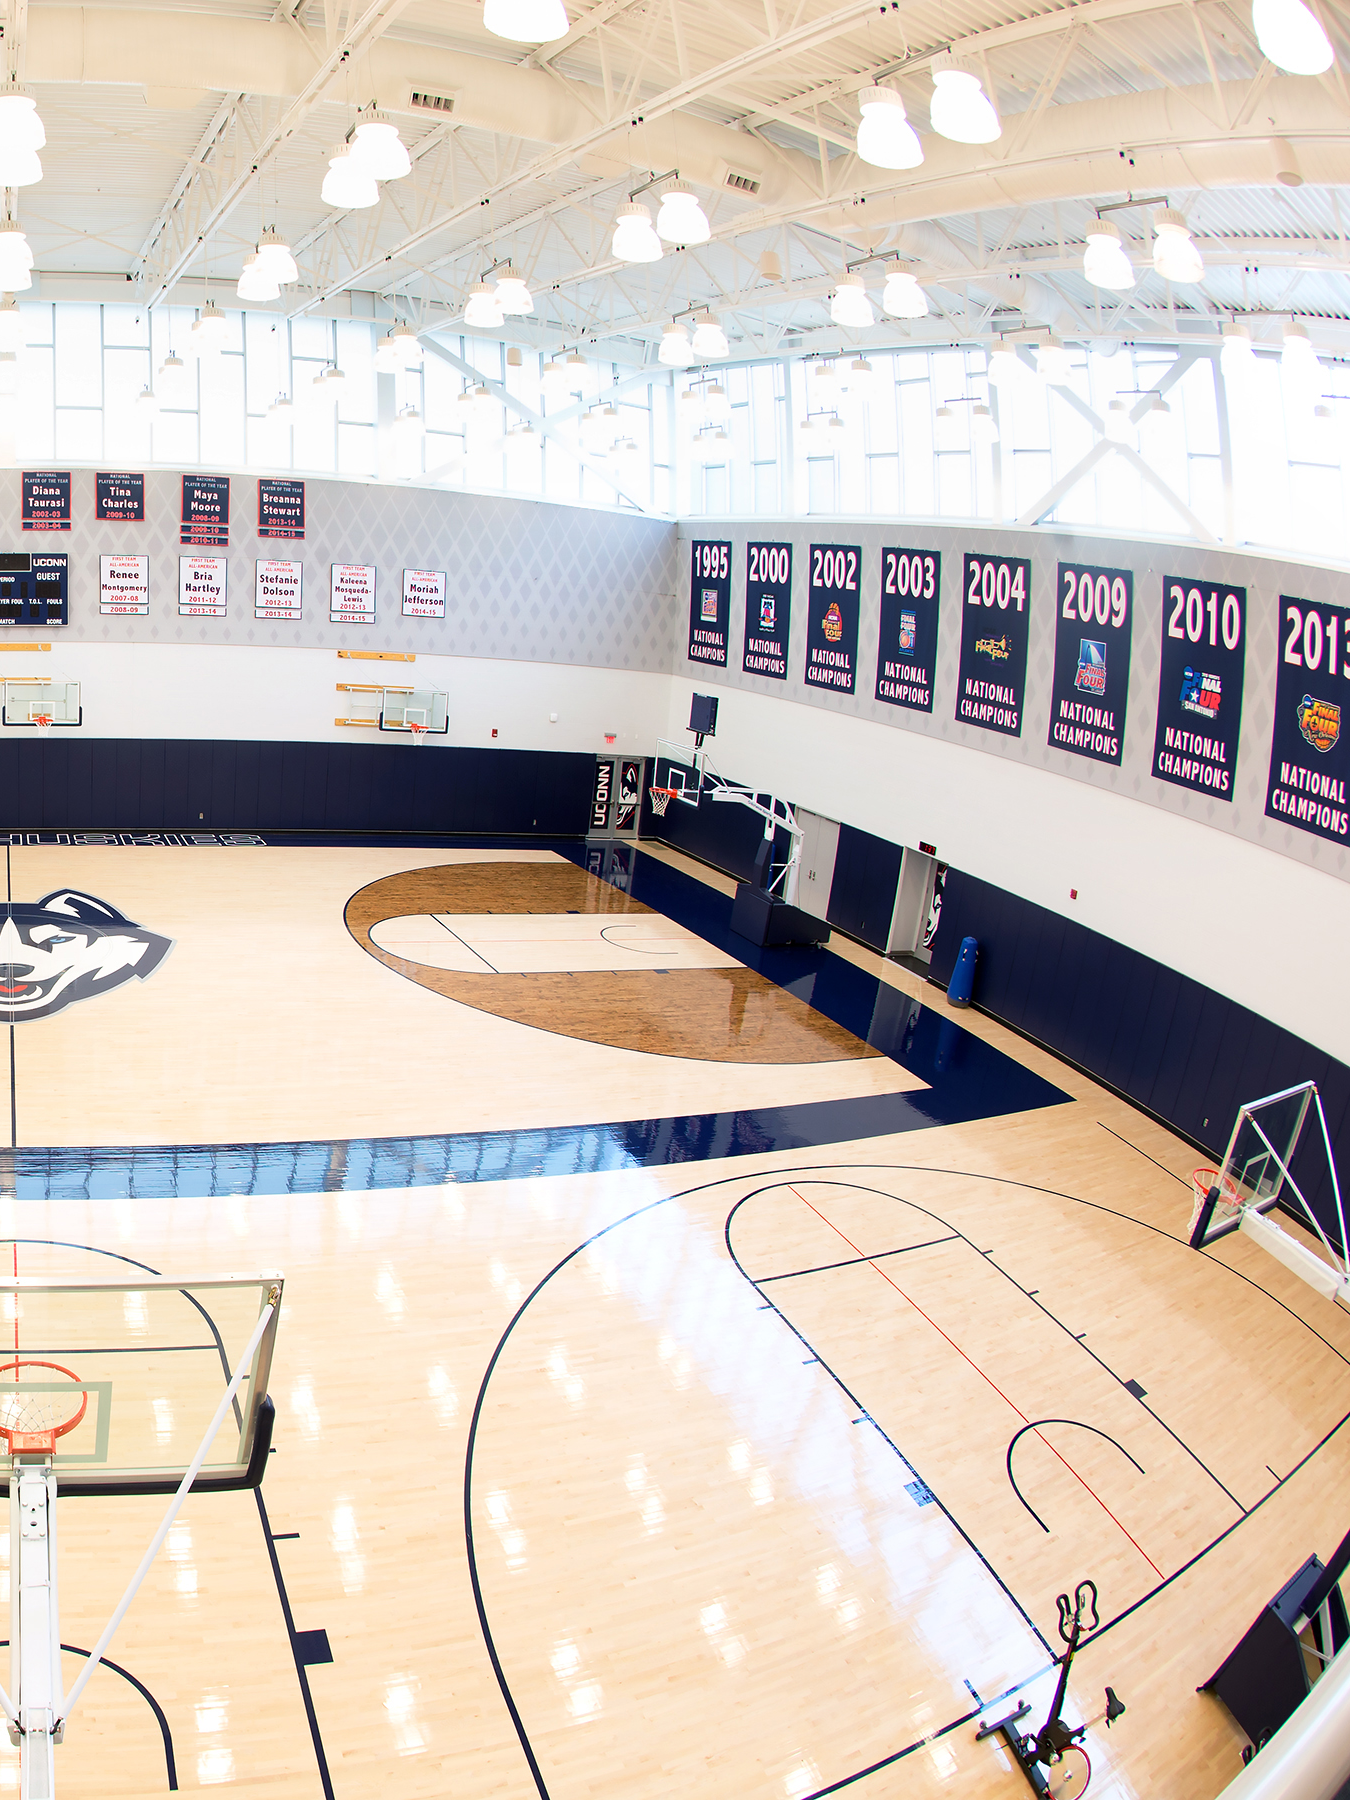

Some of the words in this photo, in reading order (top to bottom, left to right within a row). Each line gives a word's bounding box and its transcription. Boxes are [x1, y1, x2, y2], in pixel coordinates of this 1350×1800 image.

[33, 486, 60, 495] Diana
[110, 487, 131, 496] Tina
[194, 490, 218, 501] Maya
[263, 494, 301, 504] Breanna
[28, 498, 65, 507] Taurasi
[102, 499, 138, 508] Charles
[191, 501, 221, 511] Moore
[263, 506, 301, 516] Stewart
[191, 514, 220, 522] 2008-09
[33, 558, 66, 566] UCONN
[695, 545, 728, 579] 1995
[750, 547, 788, 584] 2000
[813, 550, 857, 590] 2002
[110, 570, 139, 579] Renee
[194, 571, 212, 581] Bria
[260, 574, 299, 585] Stefanie
[340, 577, 367, 585] Kaleena
[886, 553, 935, 599] 2003
[102, 584, 147, 592] Montgomery
[185, 583, 221, 595] Hartley
[263, 586, 295, 597] Dolson
[335, 586, 371, 594] Mosqueda-
[410, 584, 439, 594] Moriah
[968, 560, 1026, 612] 2004
[110, 594, 138, 602] 2007-08
[404, 595, 444, 606] Jefferson
[1062, 571, 1127, 628] 2009
[1168, 585, 1240, 650] 2010
[694, 629, 724, 646] NATIONAL
[690, 644, 725, 662] CHAMPIONS
[749, 638, 782, 656] NATIONAL
[746, 655, 785, 674] CHAMPIONS
[812, 649, 850, 668] NATIONAL
[808, 666, 852, 688] CHAMPIONS
[885, 661, 927, 685] NATIONAL
[1077, 670, 1104, 689] FOUR
[1085, 664, 1105, 677] FINAL
[1192, 672, 1221, 693] FINAL
[879, 680, 929, 706] CHAMPIONS
[965, 678, 1015, 706] NATIONAL
[960, 699, 1017, 729] CHAMPIONS
[1060, 700, 1114, 731] NATIONAL
[1312, 702, 1339, 721] FINAL
[1302, 709, 1338, 737] FOUR
[1053, 723, 1117, 757] CHAMPIONS
[1165, 727, 1226, 763] NATIONAL
[1158, 752, 1229, 791] CHAMPIONS
[1280, 761, 1345, 804] NATIONAL
[594, 766, 610, 825] UCONN
[1272, 788, 1348, 835] CHAMPIONS
